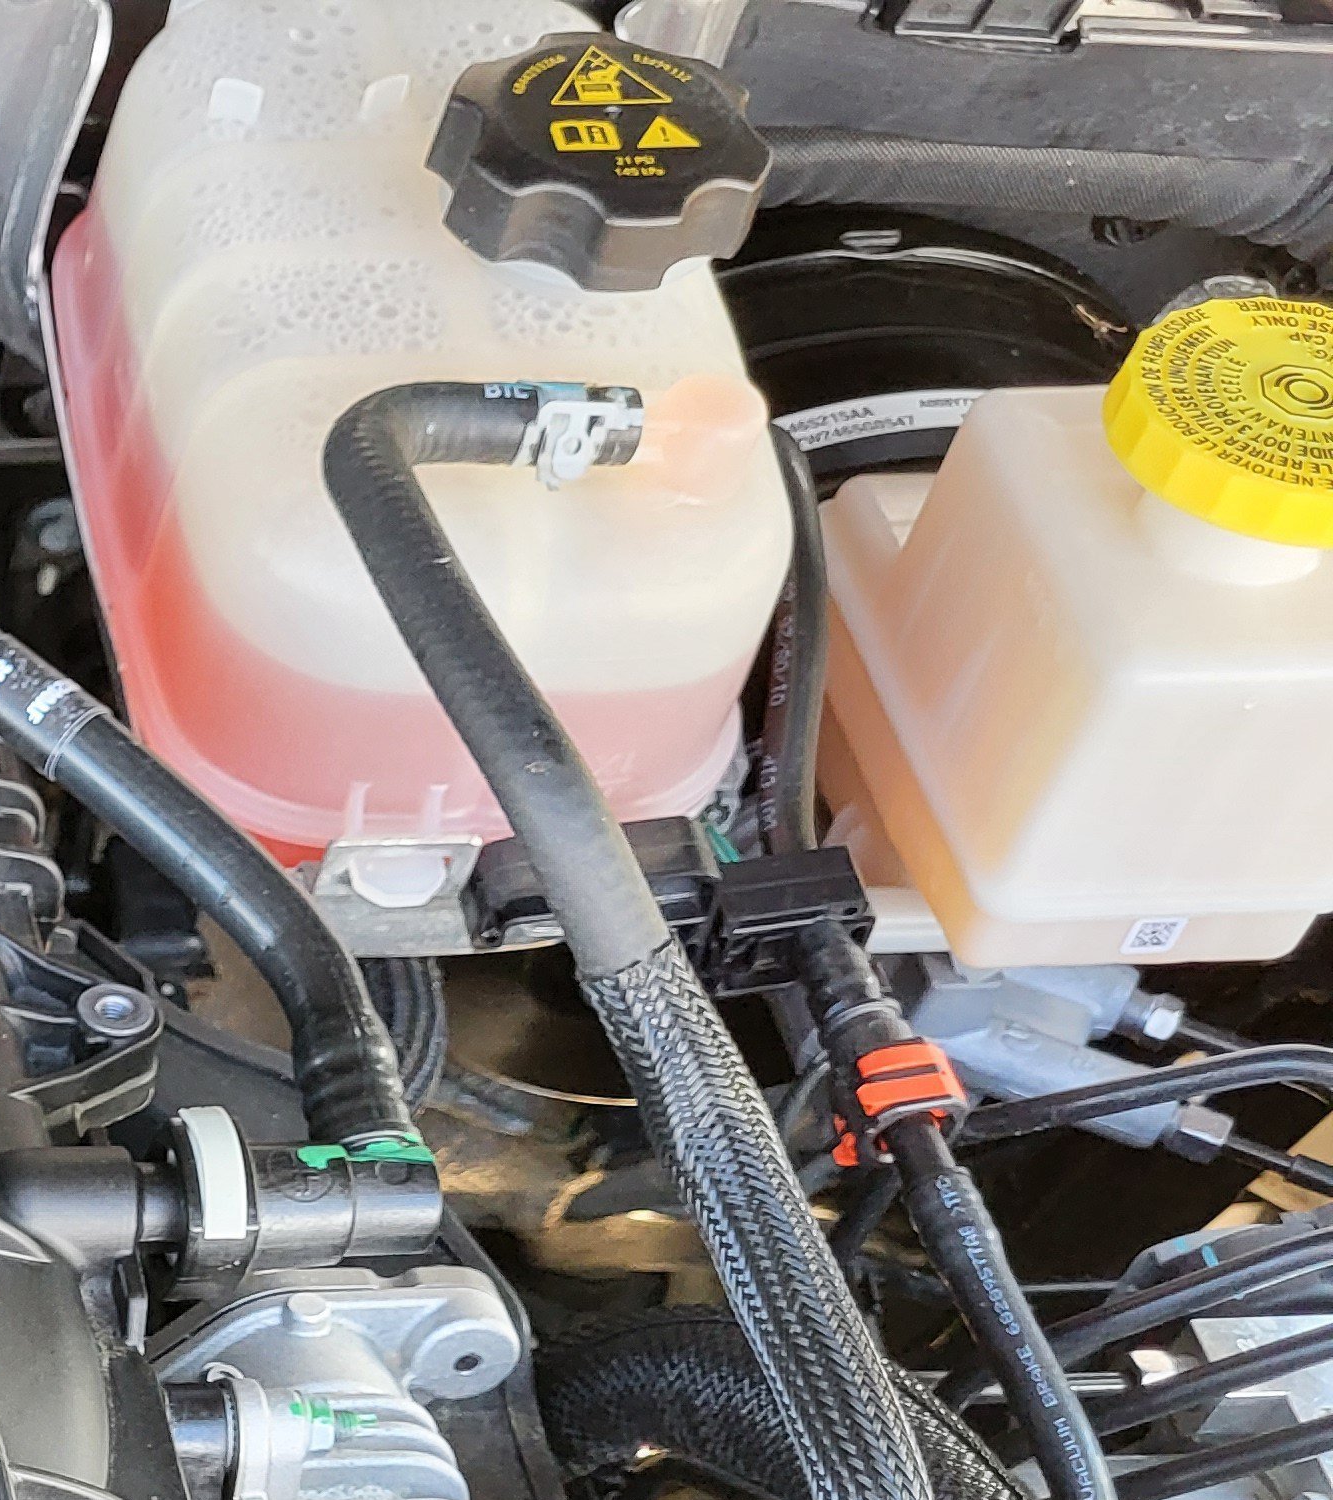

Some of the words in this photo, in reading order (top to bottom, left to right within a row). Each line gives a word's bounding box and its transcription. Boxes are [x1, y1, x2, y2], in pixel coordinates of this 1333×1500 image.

[1142, 308, 1212, 364] REMPLISSAGE
[1252, 315, 1300, 329] ONLY
[1289, 332, 1327, 347] CAP
[1142, 365, 1162, 380] DE
[1167, 324, 1219, 386] UNIQUEMENT
[1144, 383, 1201, 438] BOUCHON
[1173, 386, 1225, 436] UTILISER
[1194, 357, 1238, 428] PROVENANT
[1193, 435, 1219, 453] LE
[1223, 436, 1304, 471] RETIRER
[1249, 430, 1292, 453] DOT
[1216, 449, 1315, 489] NETTOYER
